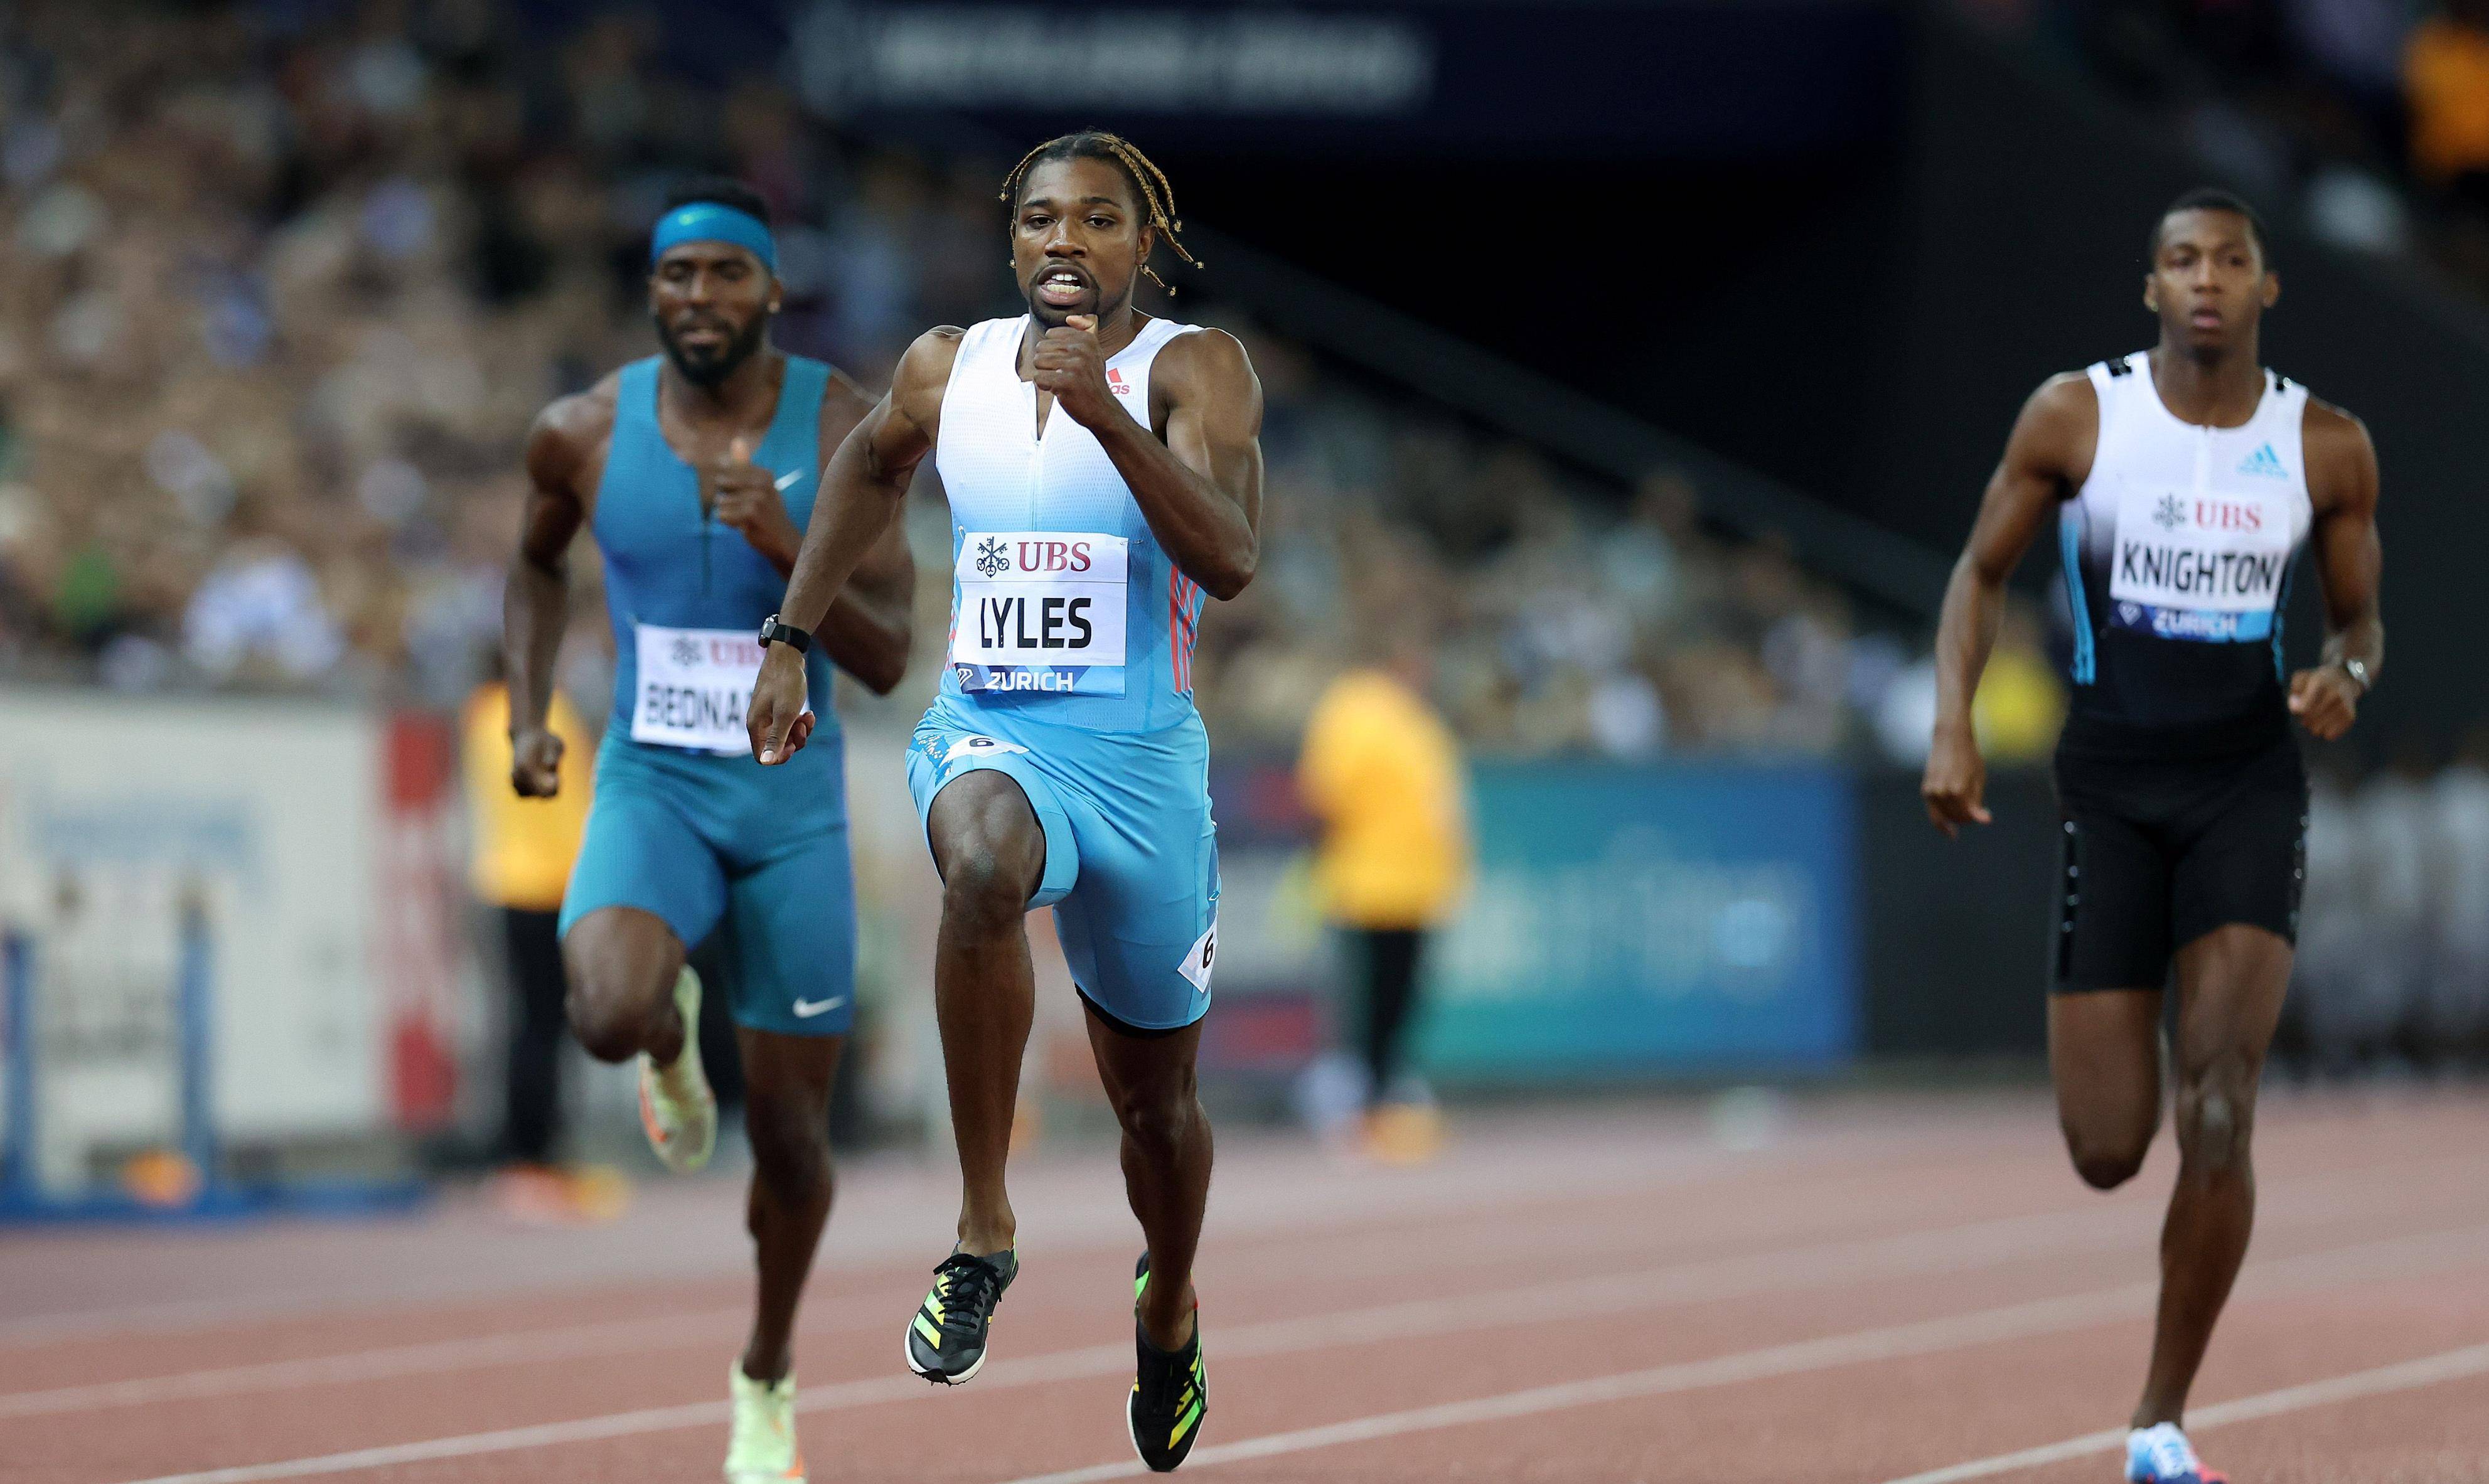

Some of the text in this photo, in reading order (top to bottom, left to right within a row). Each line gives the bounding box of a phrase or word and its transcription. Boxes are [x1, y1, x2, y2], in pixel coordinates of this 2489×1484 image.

[2196, 500, 2262, 531] UBS
[1017, 542, 1091, 572] UBS
[2122, 541, 2278, 595] KNIGHTON
[980, 598, 1092, 648] LYLES
[984, 672, 1073, 691] ZURICH
[648, 685, 752, 730] BEDNA
[969, 737, 994, 747] 6
[1202, 931, 1214, 969] 6
